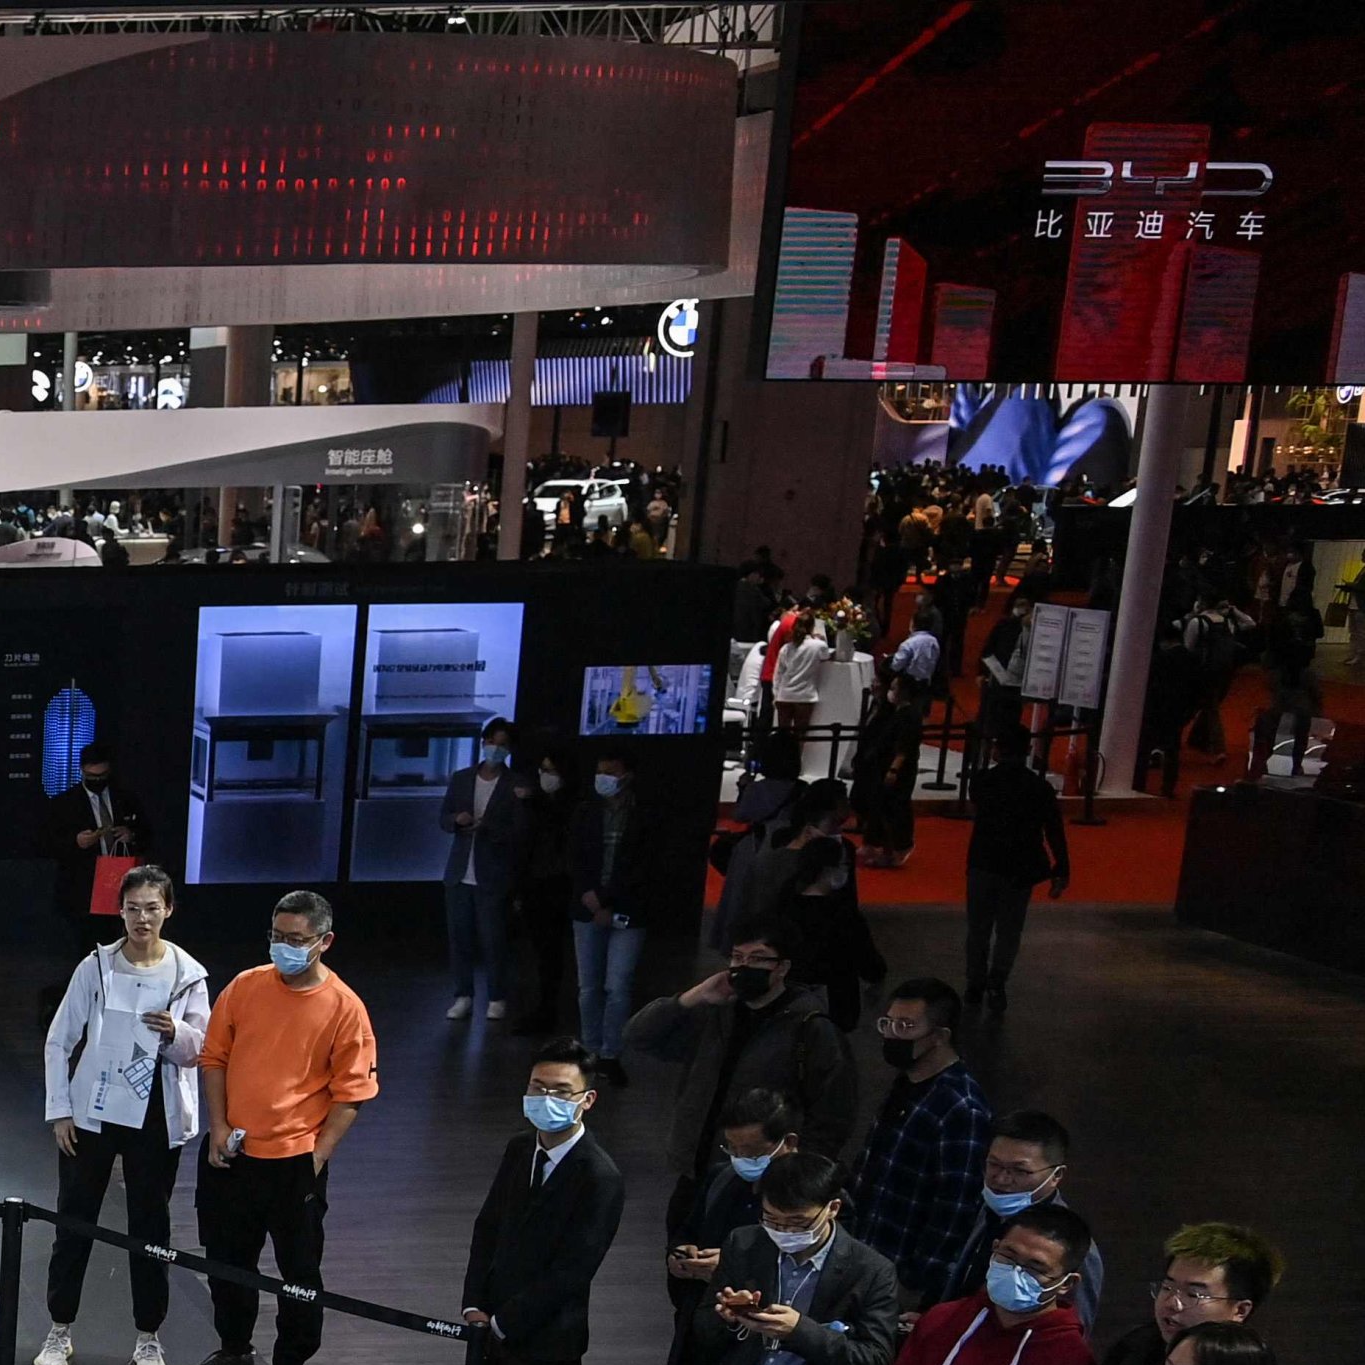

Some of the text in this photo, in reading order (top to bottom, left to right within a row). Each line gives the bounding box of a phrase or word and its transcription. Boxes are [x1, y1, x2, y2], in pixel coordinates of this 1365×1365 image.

[1041, 159, 1274, 197] BYD
[1034, 210, 1267, 241] 比亚迪汽车
[327, 448, 394, 466] 智能座舱
[325, 467, 394, 477] Intelligent Cockpit
